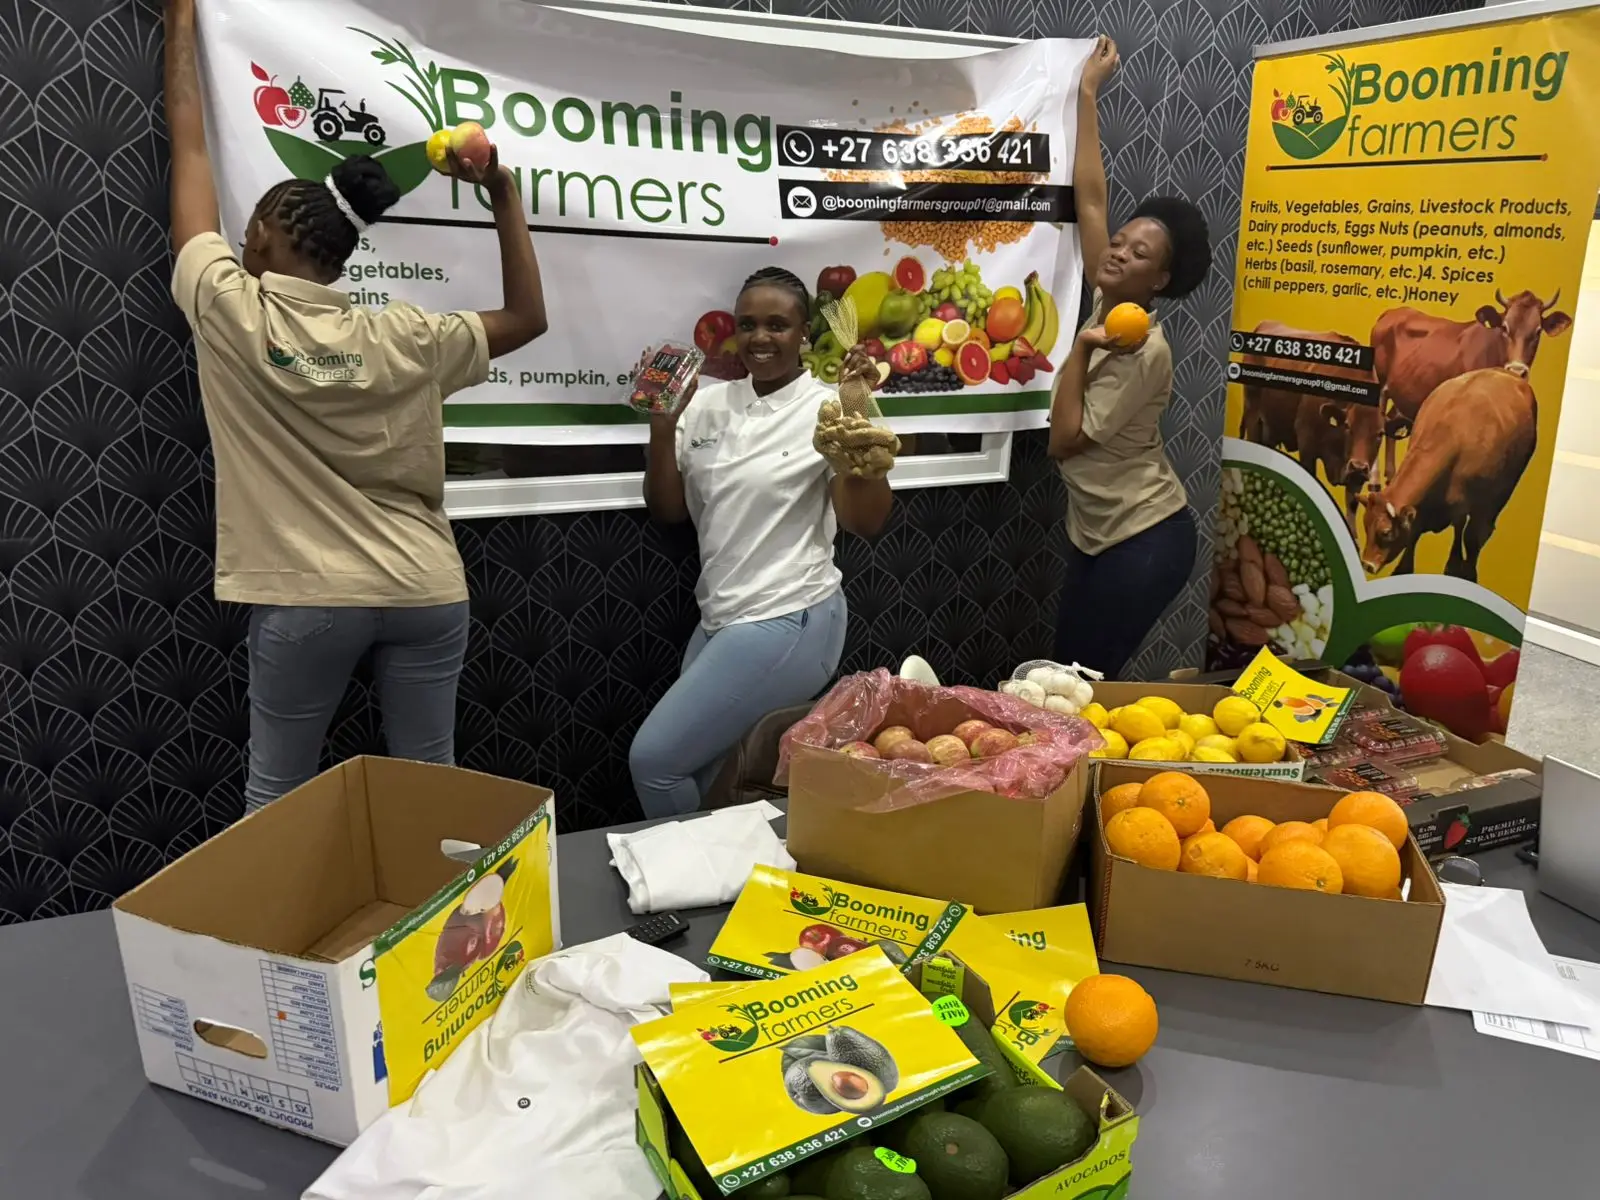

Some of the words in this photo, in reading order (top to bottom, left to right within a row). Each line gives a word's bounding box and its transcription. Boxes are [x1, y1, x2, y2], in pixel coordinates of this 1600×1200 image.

[1352, 47, 1570, 106] Booming
[438, 66, 771, 172] Booming
[1346, 113, 1518, 158] farmers
[822, 136, 872, 163] +27
[997, 138, 1033, 165] 421
[1250, 200, 1281, 214] Fruits,
[1286, 200, 1362, 216] Vegetables,
[1367, 199, 1414, 215] Grains,
[1419, 198, 1495, 215] Livestock
[1499, 198, 1572, 216] Products,
[1248, 219, 1278, 235] Dairy
[1281, 220, 1340, 236] products,
[1344, 220, 1375, 237] Eggs
[1379, 221, 1409, 236] Nuts
[1413, 220, 1488, 239] (peanuts,
[1493, 222, 1566, 241] almonds,
[1246, 238, 1273, 254] etc.)
[1276, 239, 1313, 253] Seeds
[1316, 240, 1386, 258] (sunflower,
[1390, 243, 1462, 261] pumpkin,
[1467, 245, 1506, 264] etc.)
[1245, 257, 1277, 271] Herbs
[1280, 258, 1317, 275] (basil,
[1320, 262, 1385, 280] rosemary,
[1441, 265, 1494, 284] Spices
[1243, 275, 1271, 290] (chili
[1273, 280, 1328, 295] peppers,
[1332, 282, 1372, 299] garlic,
[1246, 337, 1271, 353] +27
[1275, 338, 1301, 357] 638
[1304, 342, 1332, 361] 336
[1335, 347, 1361, 366] 421
[520, 369, 611, 388] pumpkin,
[1240, 666, 1272, 700] Booming
[1464, 823, 1538, 845] STRAWBERRIES
[1481, 817, 1527, 834] PREMIUM
[483, 851, 497, 869] 421
[828, 909, 909, 941] farmers
[834, 893, 930, 932] Booming
[939, 916, 953, 934] +27
[925, 932, 942, 951] 638
[721, 960, 742, 970] +27
[744, 966, 765, 976] 638
[435, 961, 497, 1028] farmers
[747, 974, 859, 1020] Booming
[424, 981, 499, 1063] Booming
[761, 998, 854, 1041] farmers
[186, 1083, 218, 1100] AFRICA
[220, 1095, 252, 1112] SOUTH
[254, 1106, 267, 1115] OF
[268, 1111, 313, 1130] PRODUCT
[741, 1162, 766, 1180] +27
[769, 1150, 796, 1168] 638
[796, 1138, 822, 1156] 336
[824, 1127, 848, 1145] 421
[1054, 1149, 1127, 1194] AVOCADOS
